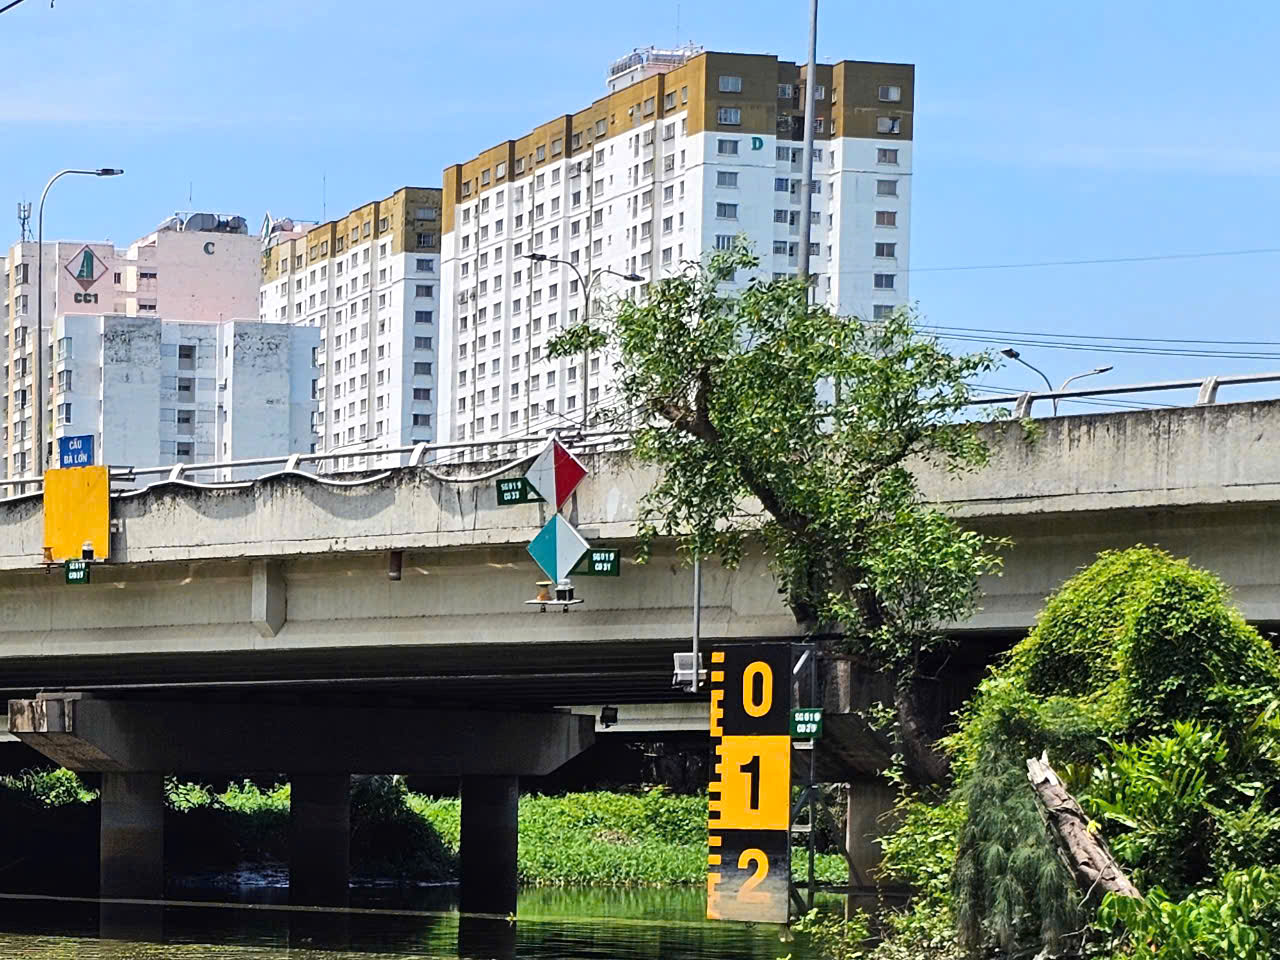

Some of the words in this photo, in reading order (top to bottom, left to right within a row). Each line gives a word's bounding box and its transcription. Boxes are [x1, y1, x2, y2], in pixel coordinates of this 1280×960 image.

[752, 137, 764, 151] D
[203, 241, 215, 255] C
[74, 292, 99, 305] CC1
[742, 661, 773, 717] 0
[739, 755, 761, 811] 1
[736, 847, 770, 901] 2
